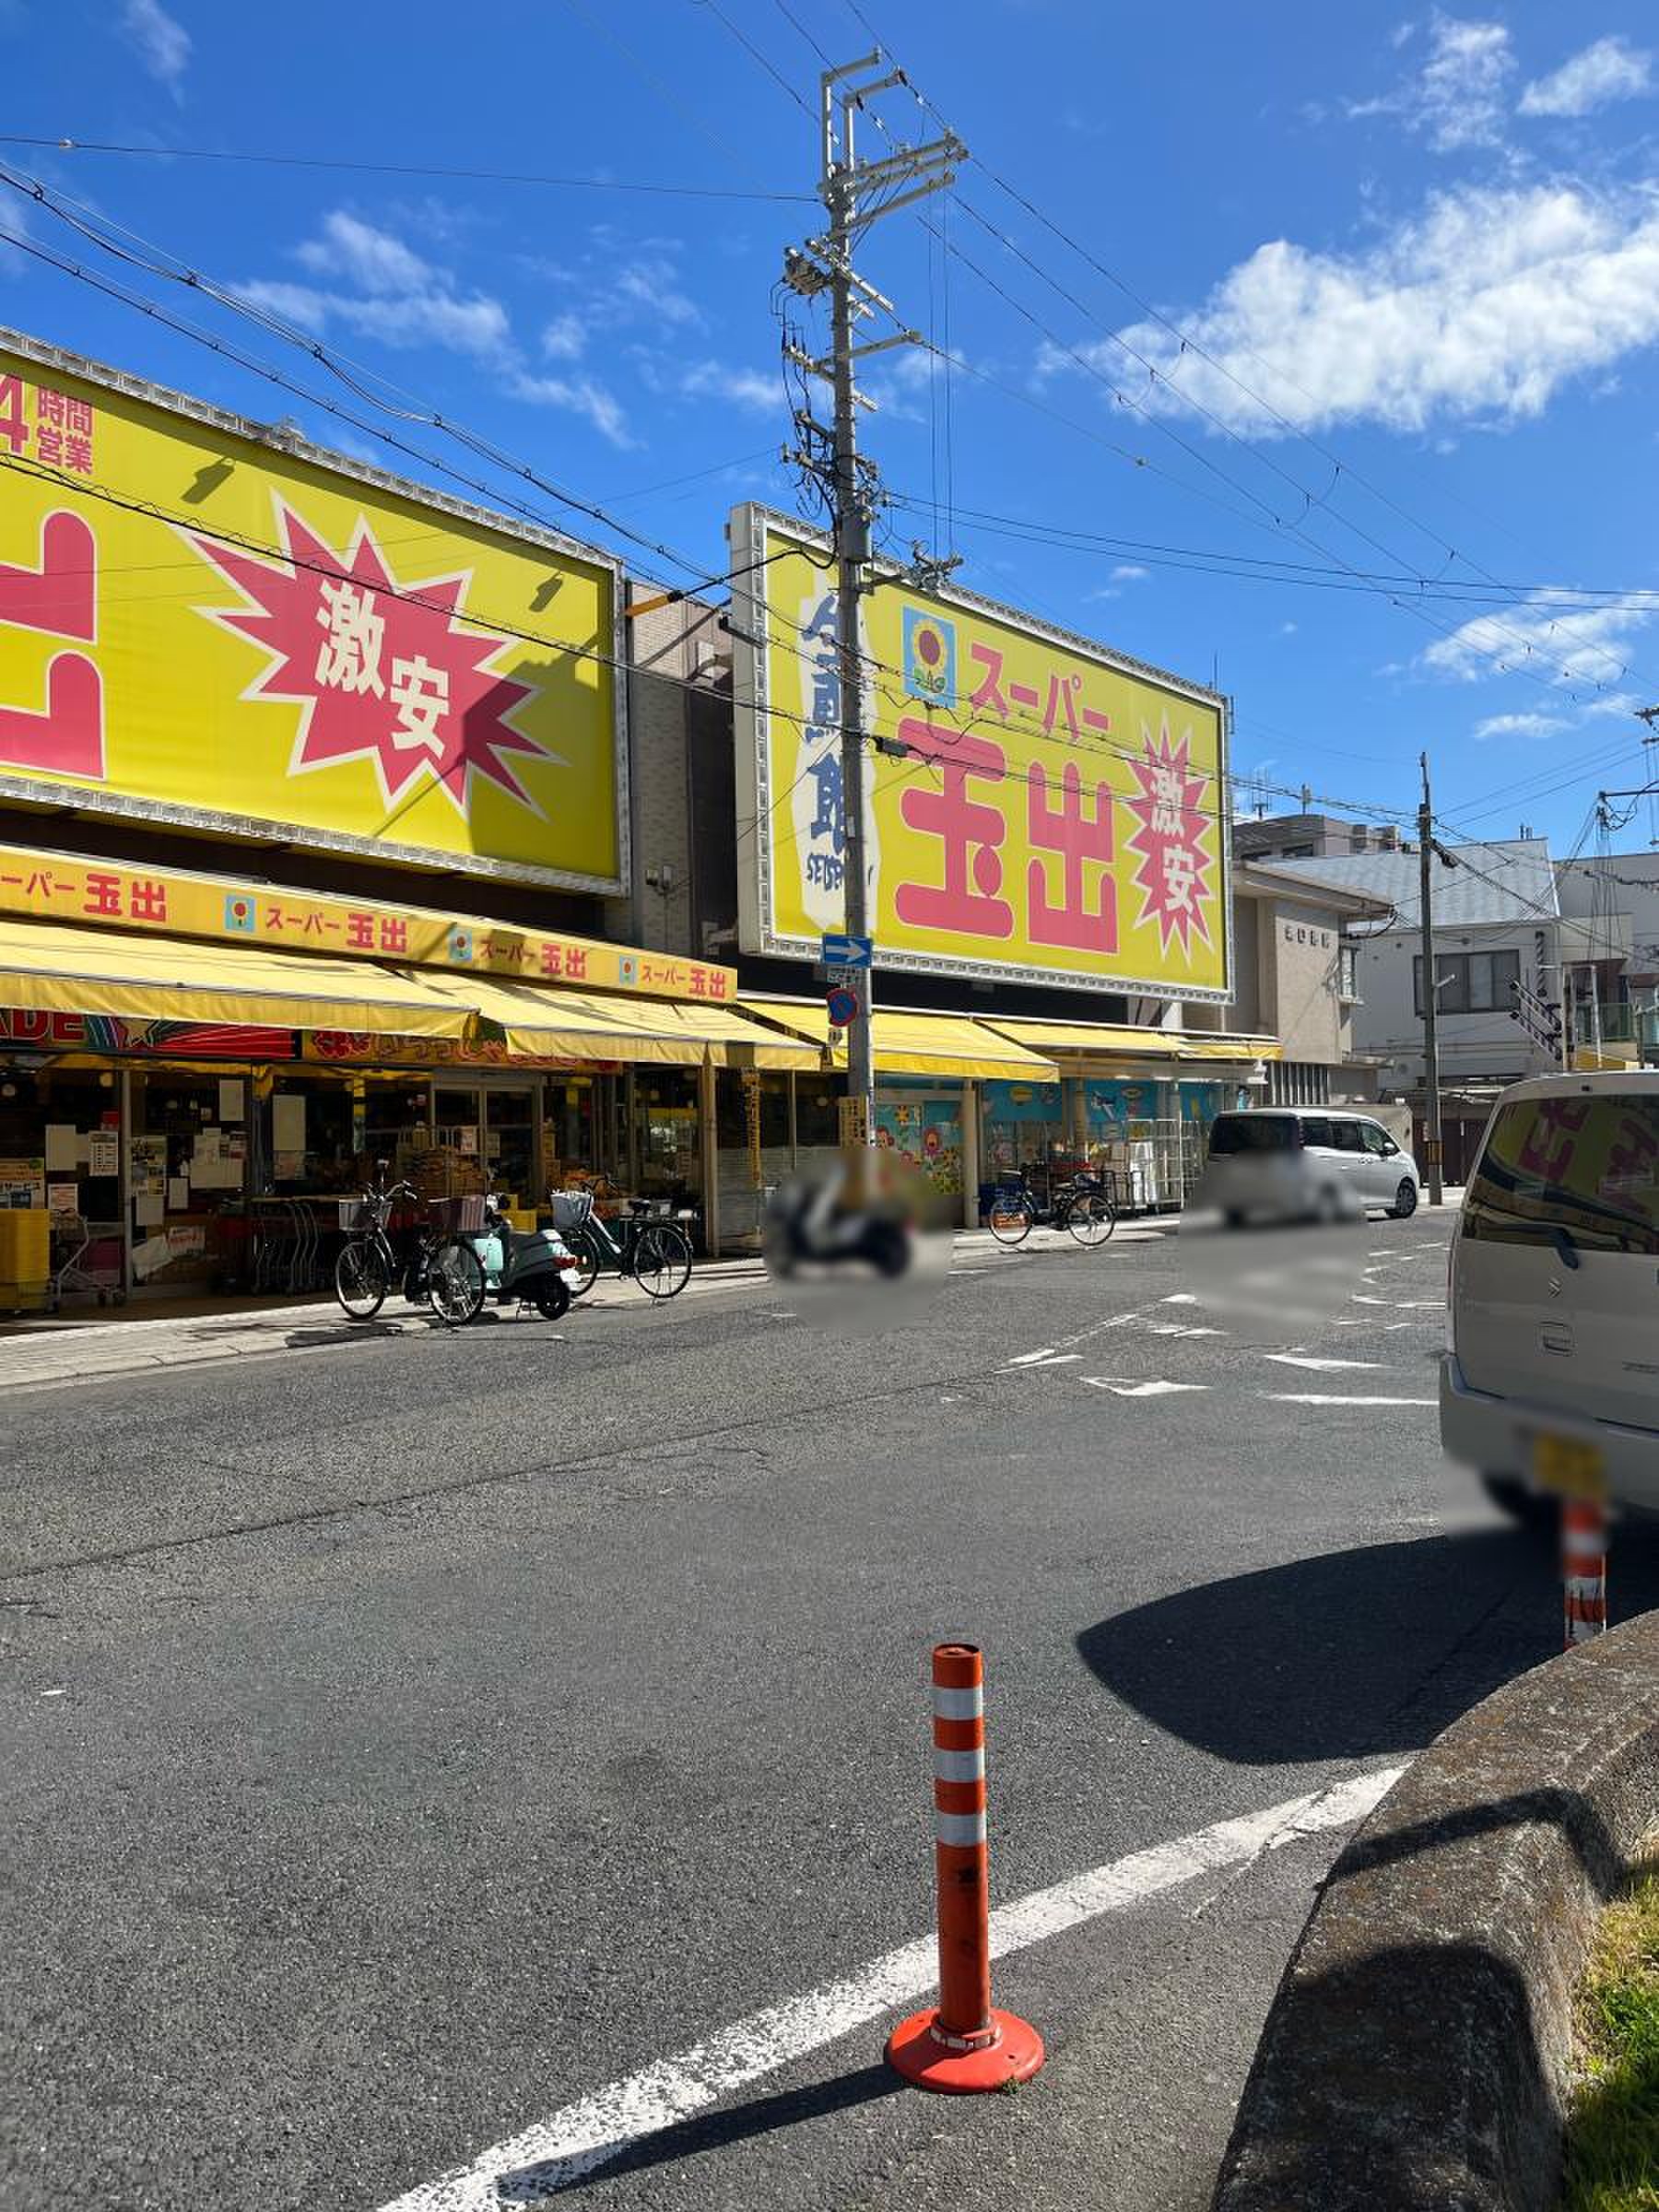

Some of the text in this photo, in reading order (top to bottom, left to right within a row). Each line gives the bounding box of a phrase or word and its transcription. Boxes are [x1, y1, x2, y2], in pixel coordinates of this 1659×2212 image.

[37, 426, 93, 476] 営業
[38, 385, 93, 437] 時間
[315, 581, 450, 756] 激安
[971, 643, 1110, 746] スーパー
[896, 715, 1121, 955] 玉出
[1149, 767, 1198, 913] 激安
